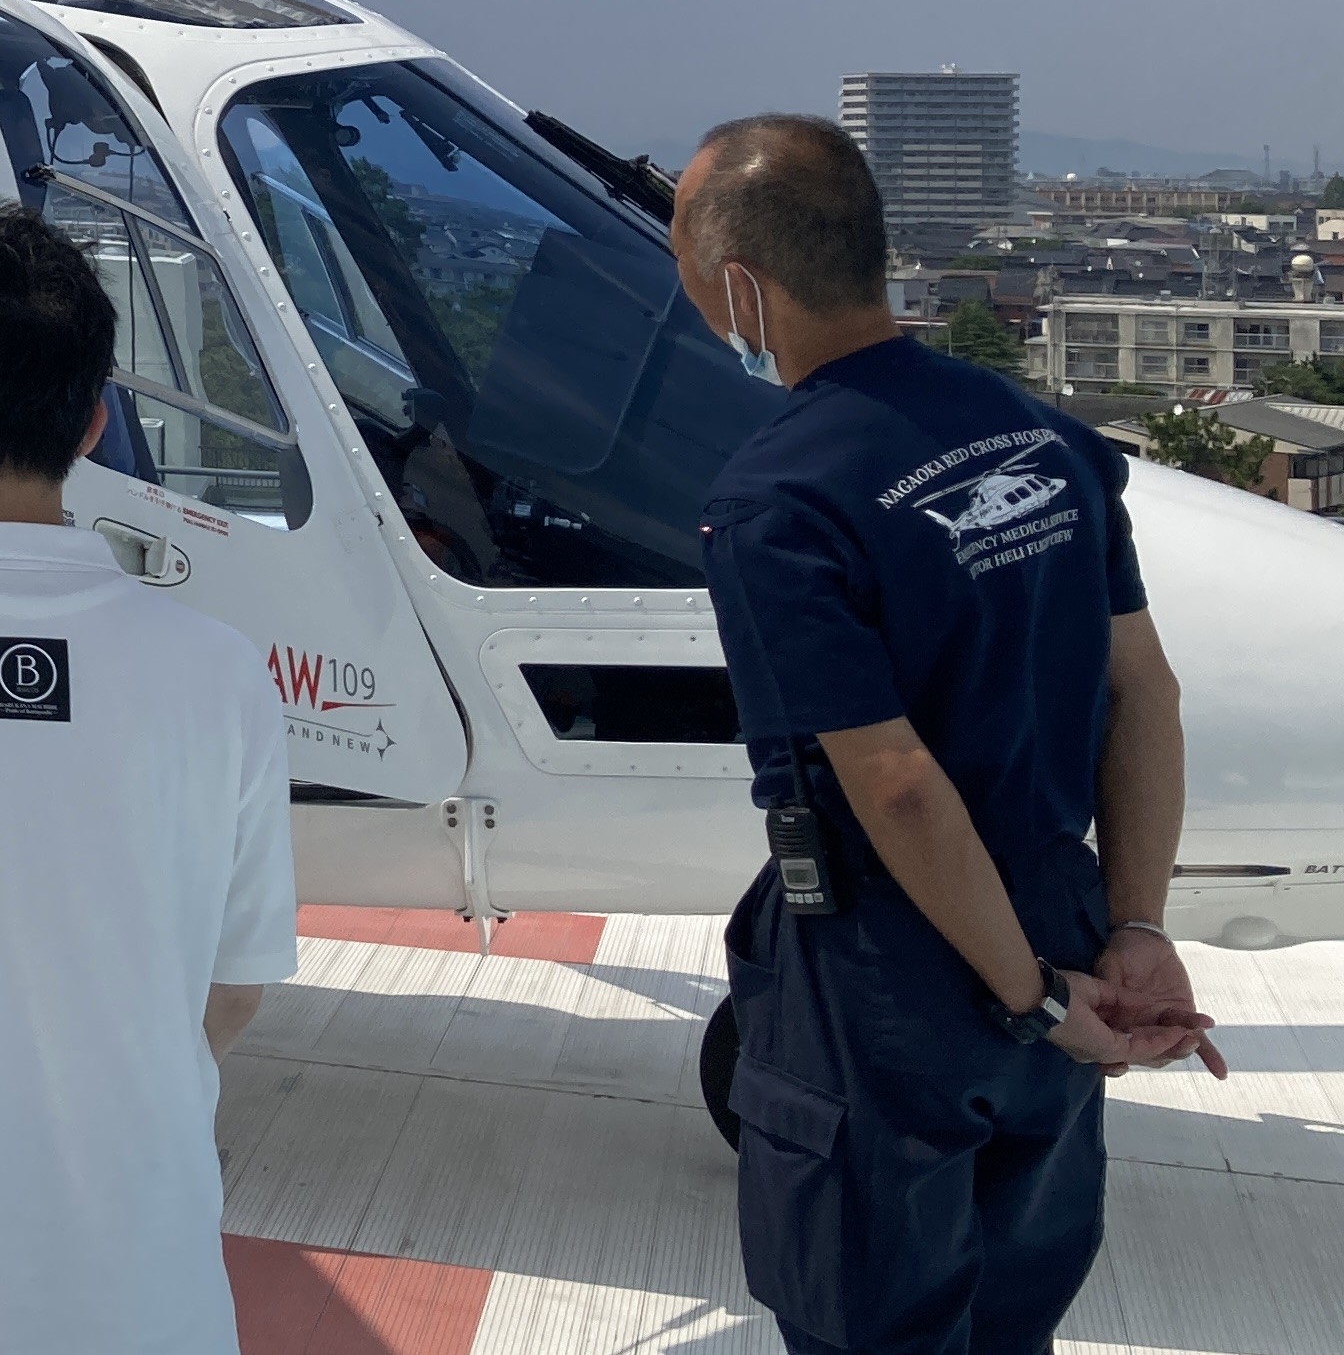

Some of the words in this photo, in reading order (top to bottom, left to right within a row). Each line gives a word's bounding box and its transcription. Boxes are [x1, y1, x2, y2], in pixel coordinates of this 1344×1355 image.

[876, 460, 945, 510] NAGAOKA
[941, 447, 969, 469] RED
[969, 434, 1012, 457] CROSS
[1000, 516, 1050, 544] MEDICAL
[994, 546, 1027, 568] HELI
[15, 654, 40, 686] B
[287, 724, 371, 753] ANDNEW
